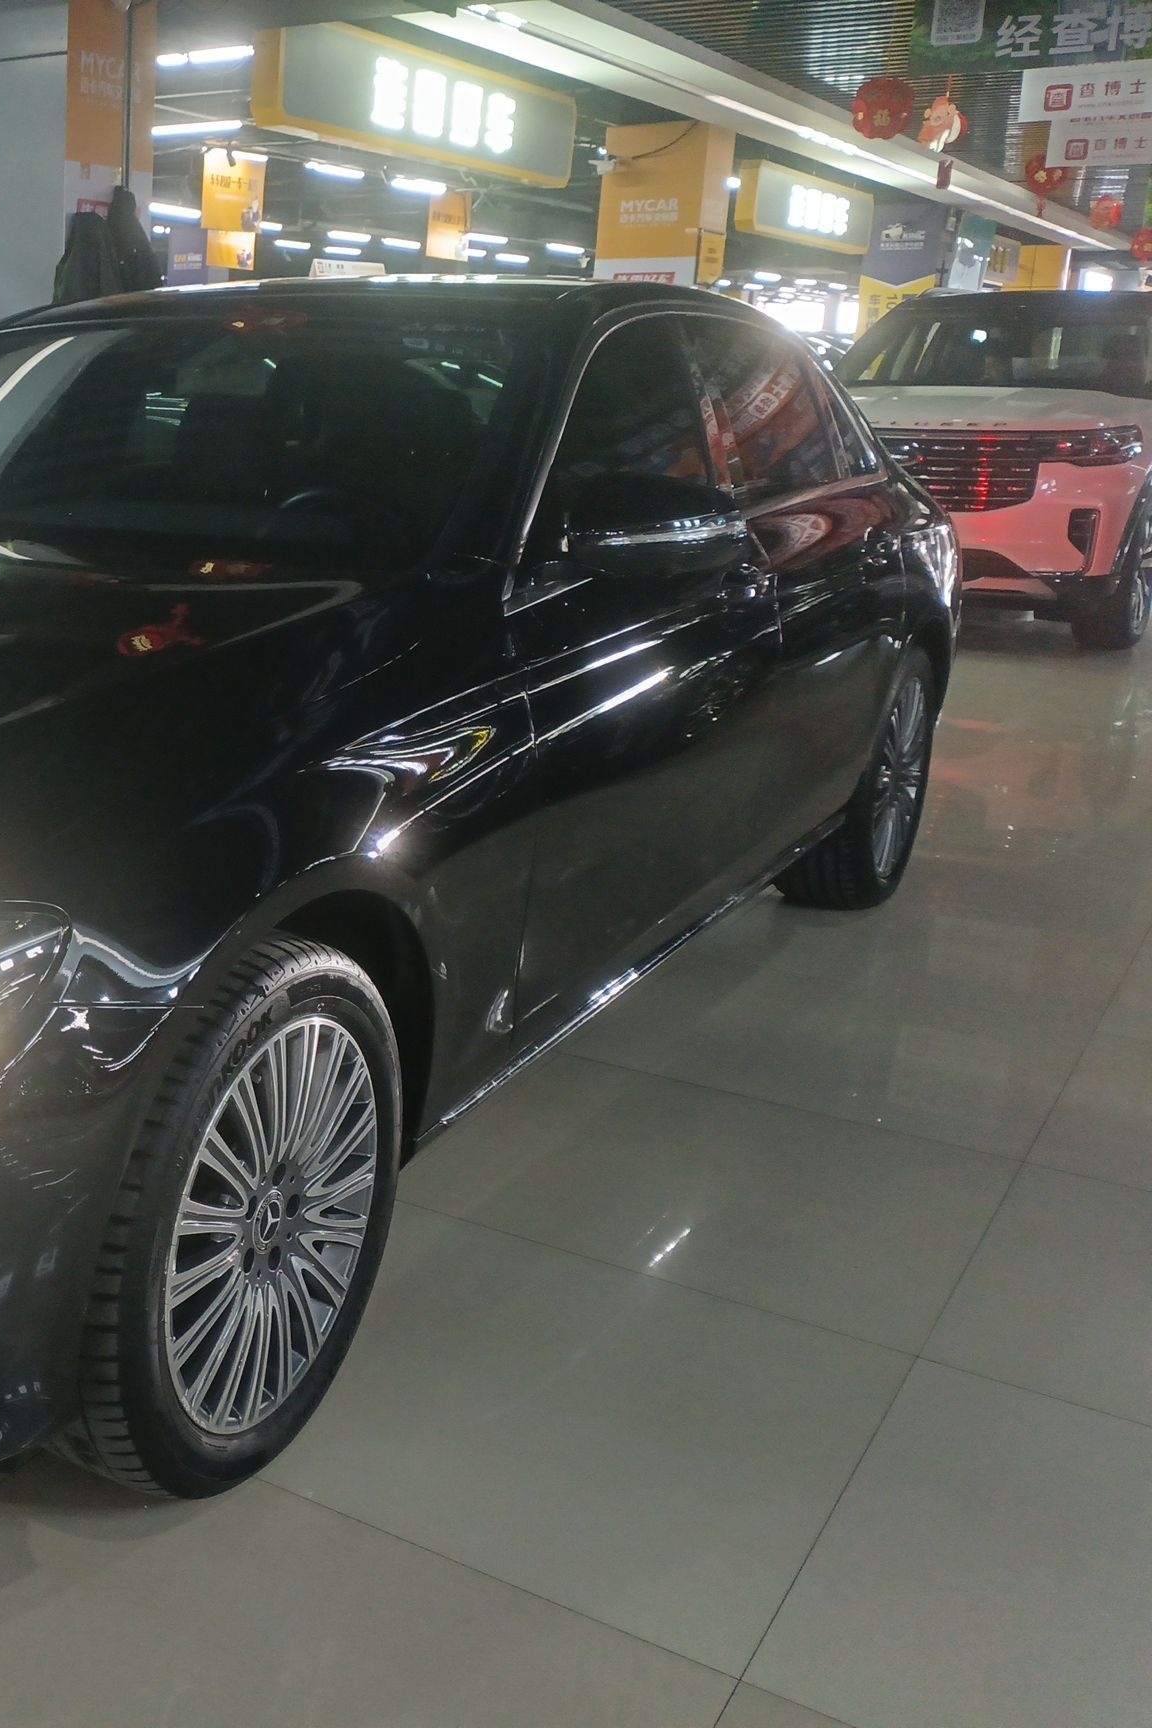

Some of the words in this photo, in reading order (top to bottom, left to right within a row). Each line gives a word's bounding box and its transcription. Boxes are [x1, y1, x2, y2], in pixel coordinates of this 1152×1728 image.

[995, 4, 1152, 57] 经查博
[1079, 79, 1147, 98] 查博士
[620, 198, 678, 212] MYCAR
